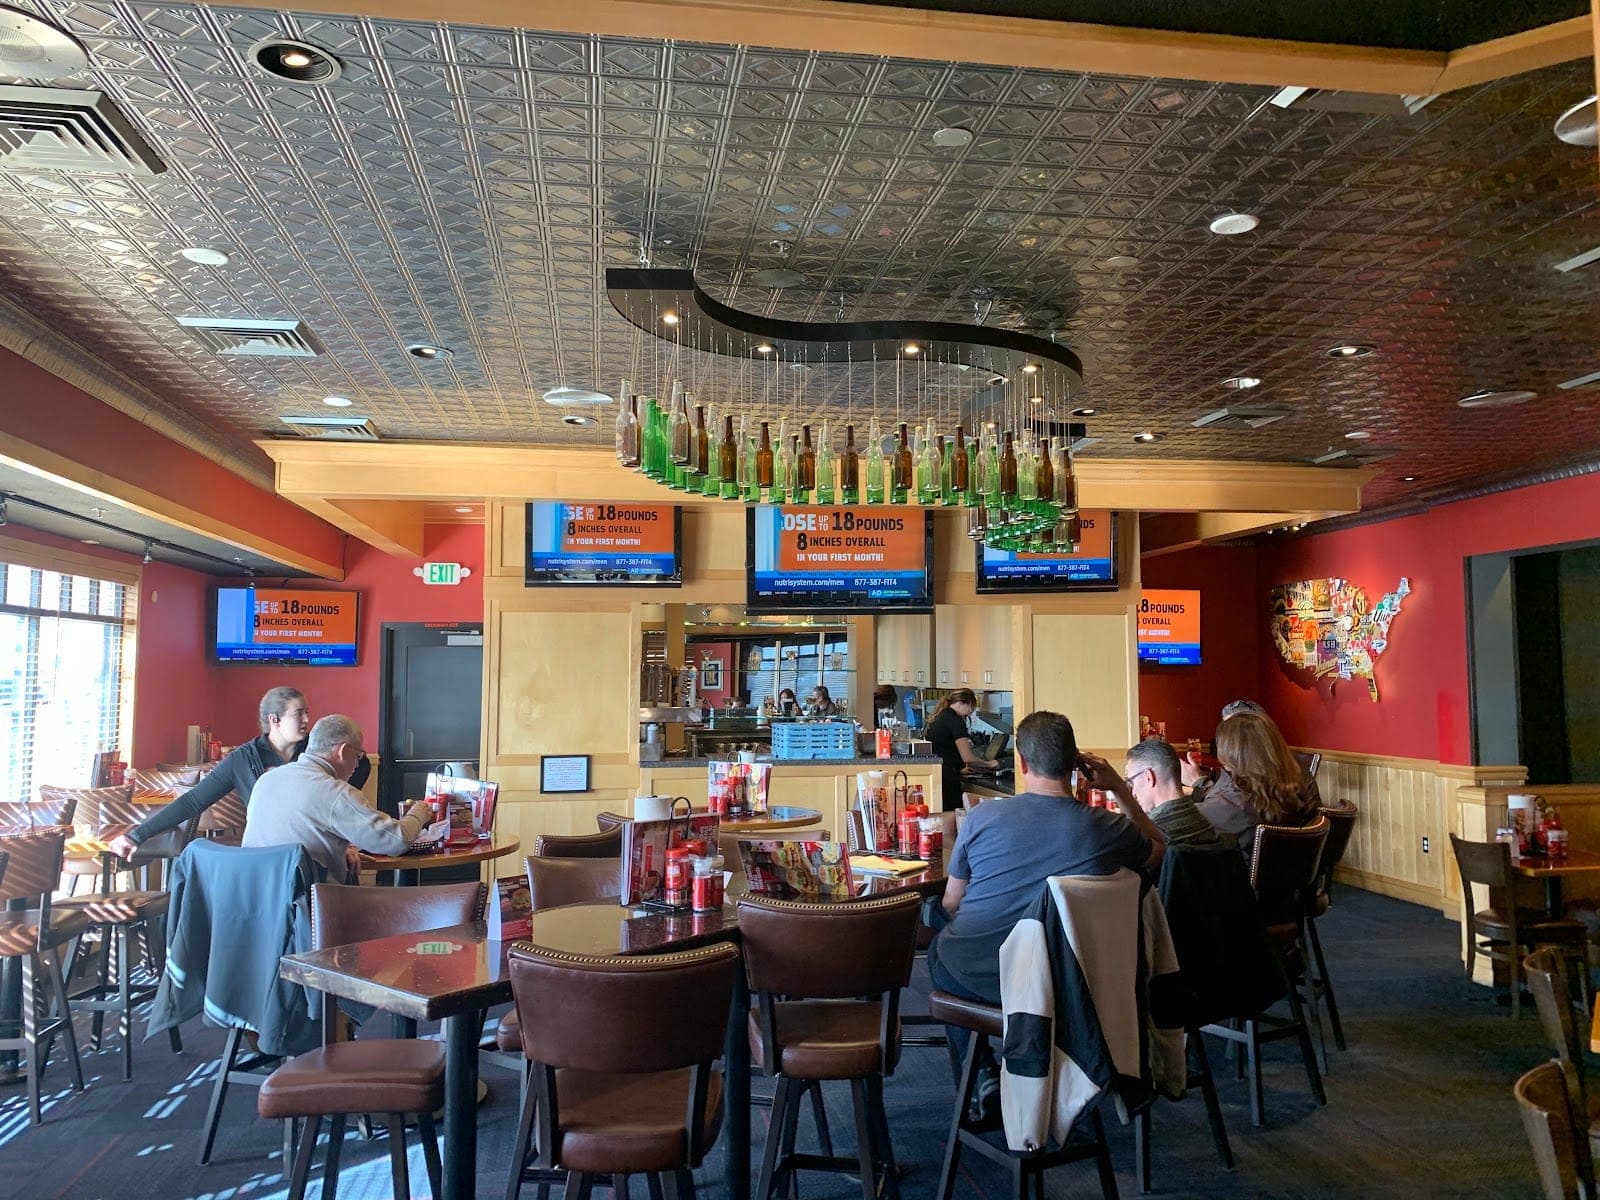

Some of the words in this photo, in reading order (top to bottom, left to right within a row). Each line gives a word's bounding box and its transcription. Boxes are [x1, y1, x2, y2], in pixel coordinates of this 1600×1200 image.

[564, 506, 584, 520] SE
[597, 505, 616, 520] 18
[618, 511, 658, 521] POUNDS
[818, 523, 829, 531] TO
[832, 512, 854, 530] 18
[856, 518, 904, 530] POUNDS
[568, 522, 576, 536] 8
[578, 525, 606, 533] INCHES
[608, 526, 642, 534] OVERALL
[797, 533, 808, 550] 8
[810, 537, 842, 546] INCHES
[846, 537, 886, 546] OVERALL
[796, 554, 804, 562] IN
[807, 554, 828, 562] YOUR
[830, 554, 852, 562] FIRST
[854, 554, 884, 562] MONTH!
[430, 564, 456, 582] EXIT
[774, 578, 844, 588] nutrisystem.com/men
[282, 600, 300, 614] 18
[300, 605, 340, 614] POUNDS
[1150, 604, 1184, 614] POUNDS
[291, 618, 324, 626] OVERALL
